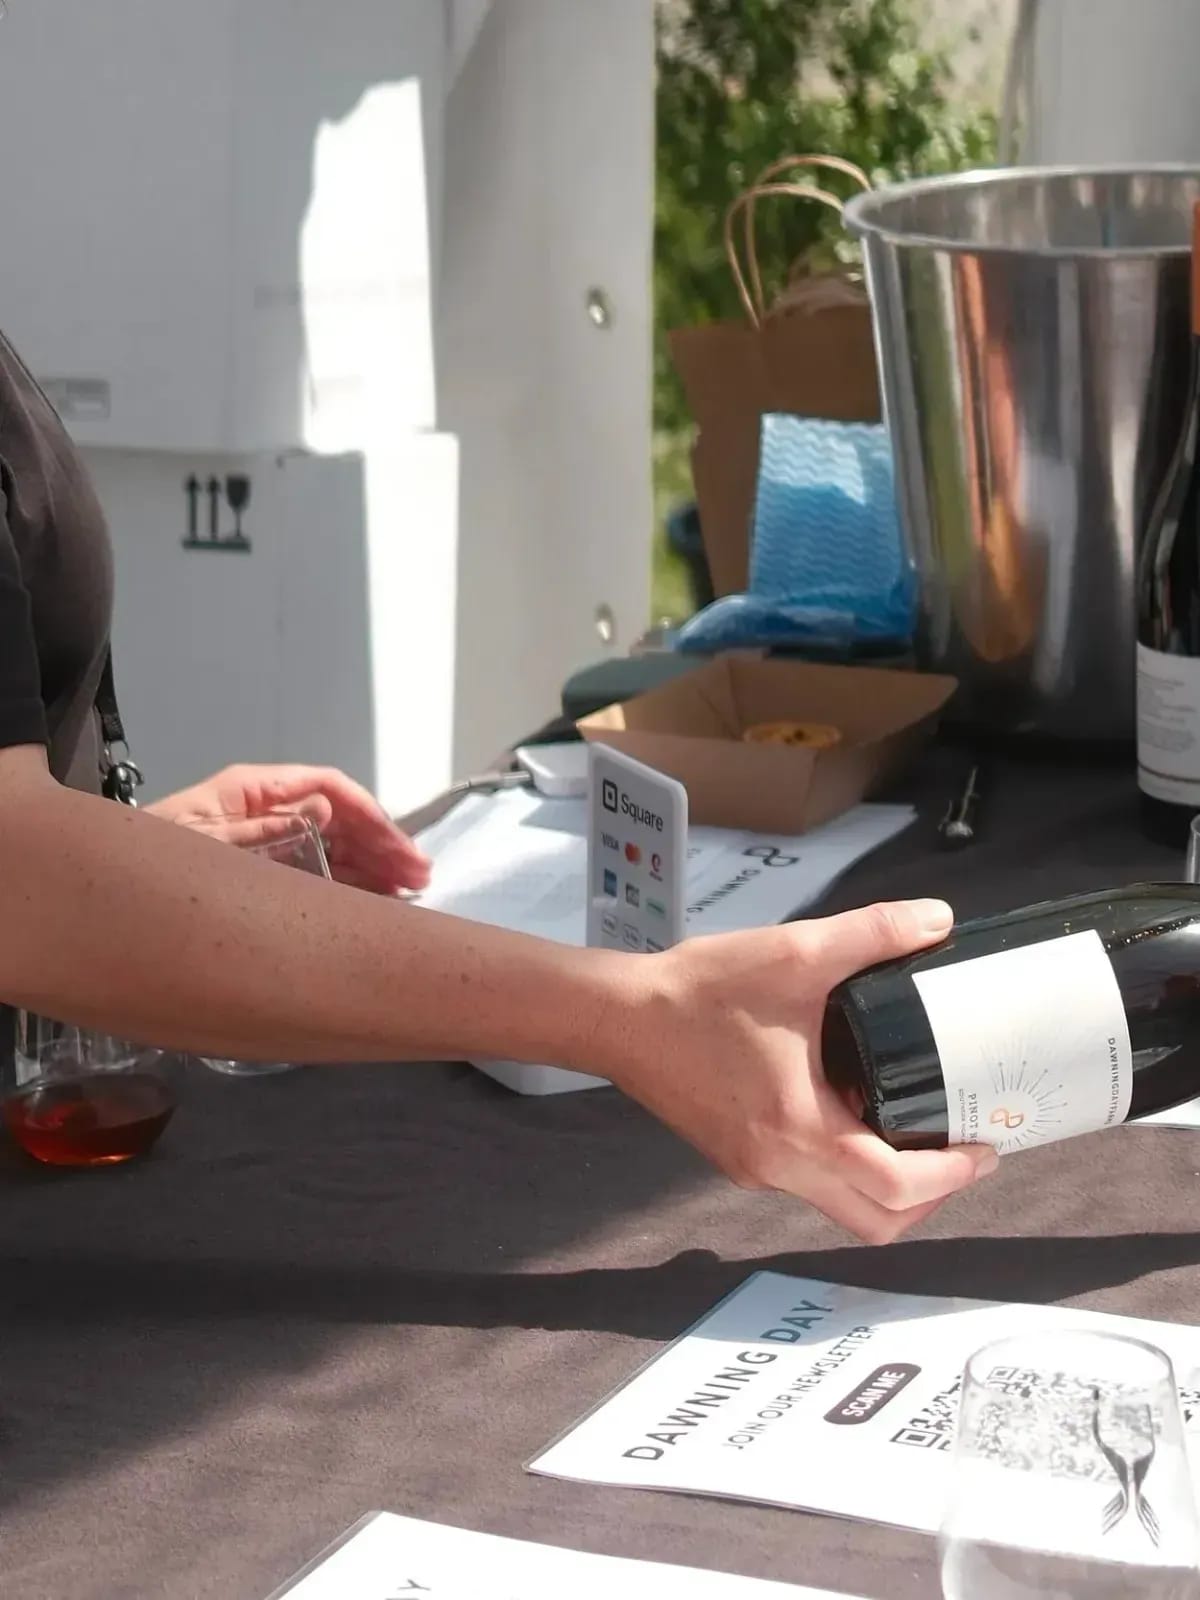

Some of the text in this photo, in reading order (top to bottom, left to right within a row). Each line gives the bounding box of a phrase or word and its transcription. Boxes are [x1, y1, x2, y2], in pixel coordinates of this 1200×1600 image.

[620, 793, 664, 832] Square
[968, 1093, 979, 1129] PINOT
[621, 1299, 834, 1460] DAWNING DAY
[722, 1325, 880, 1450] JOIN OUR NEWSLETTER
[842, 1370, 906, 1417] SCAN ME
